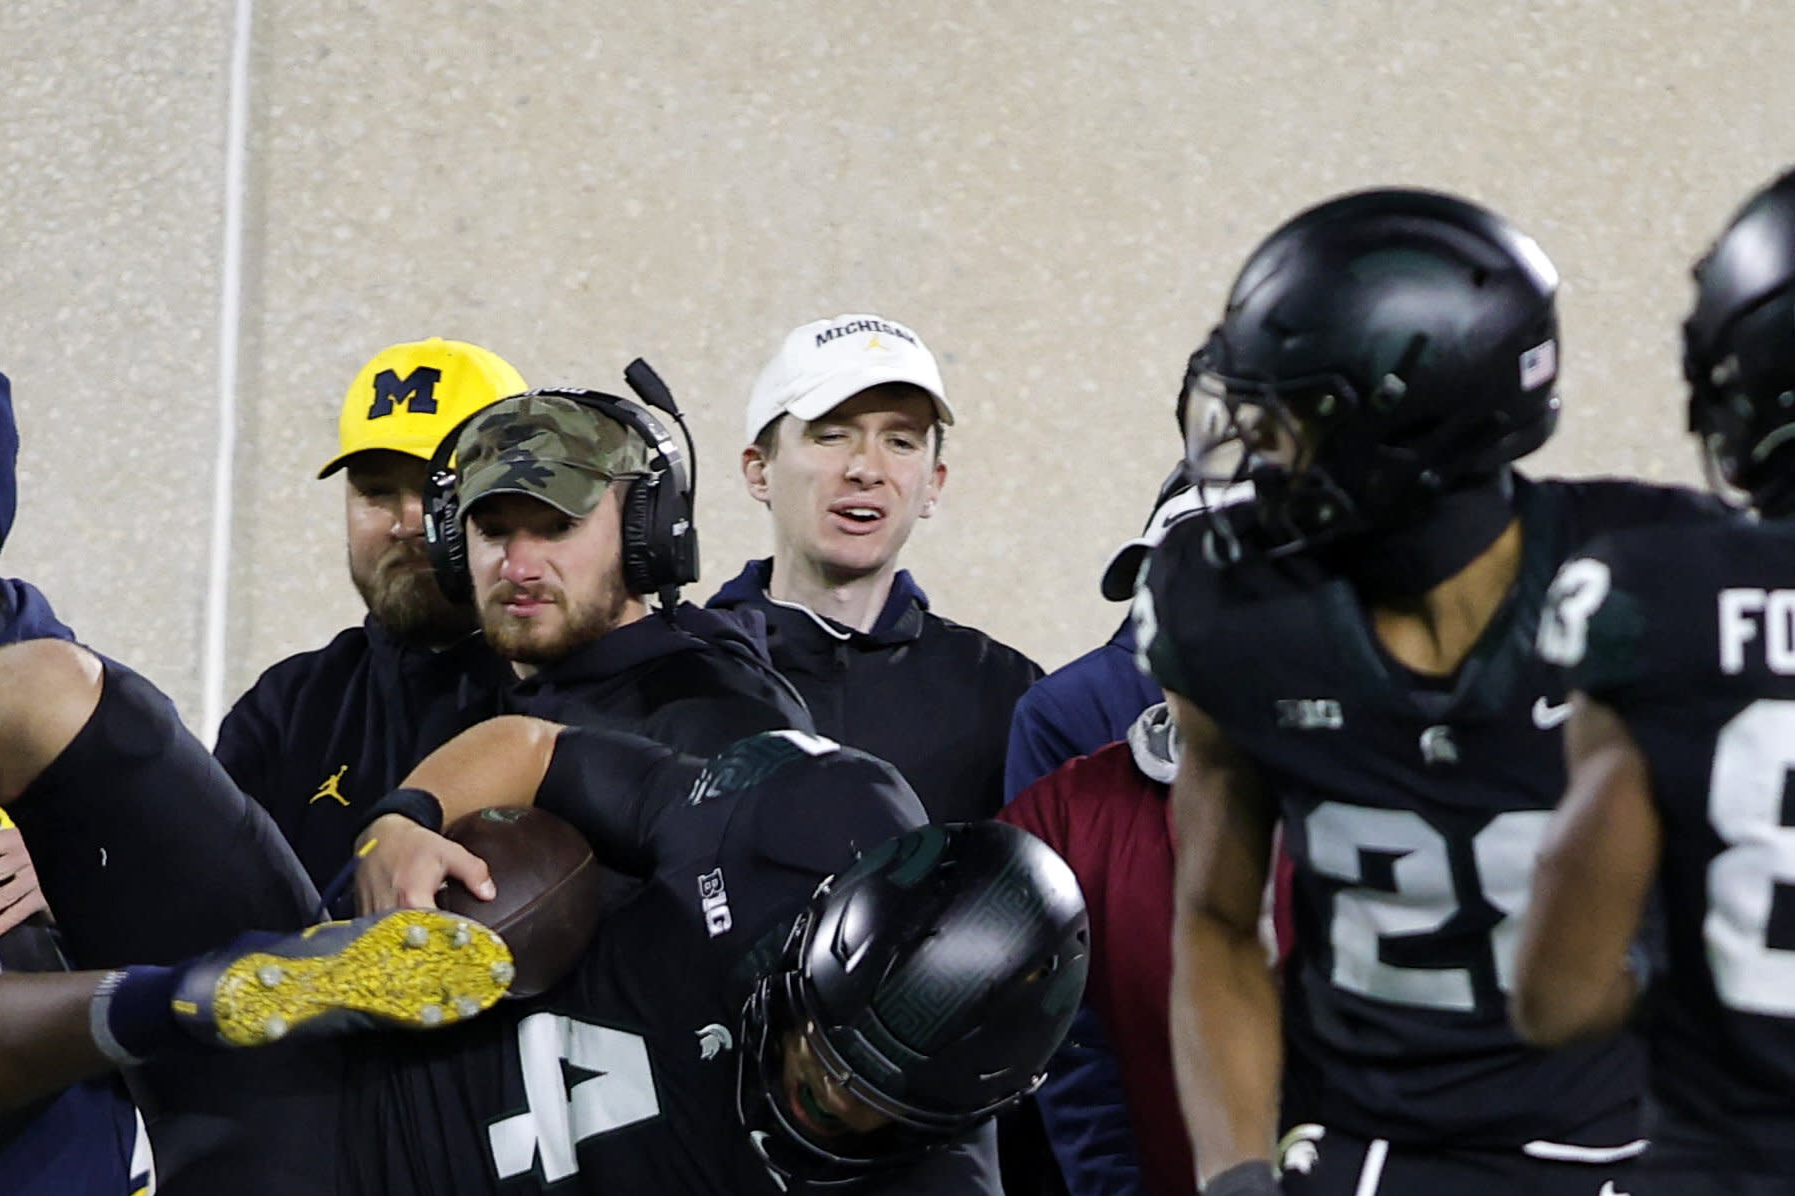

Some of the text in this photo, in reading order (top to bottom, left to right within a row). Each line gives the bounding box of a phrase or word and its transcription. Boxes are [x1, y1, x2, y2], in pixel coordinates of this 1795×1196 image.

[815, 319, 919, 348] MICHIGAN
[367, 366, 442, 420] M
[488, 1012, 660, 1184] 4
